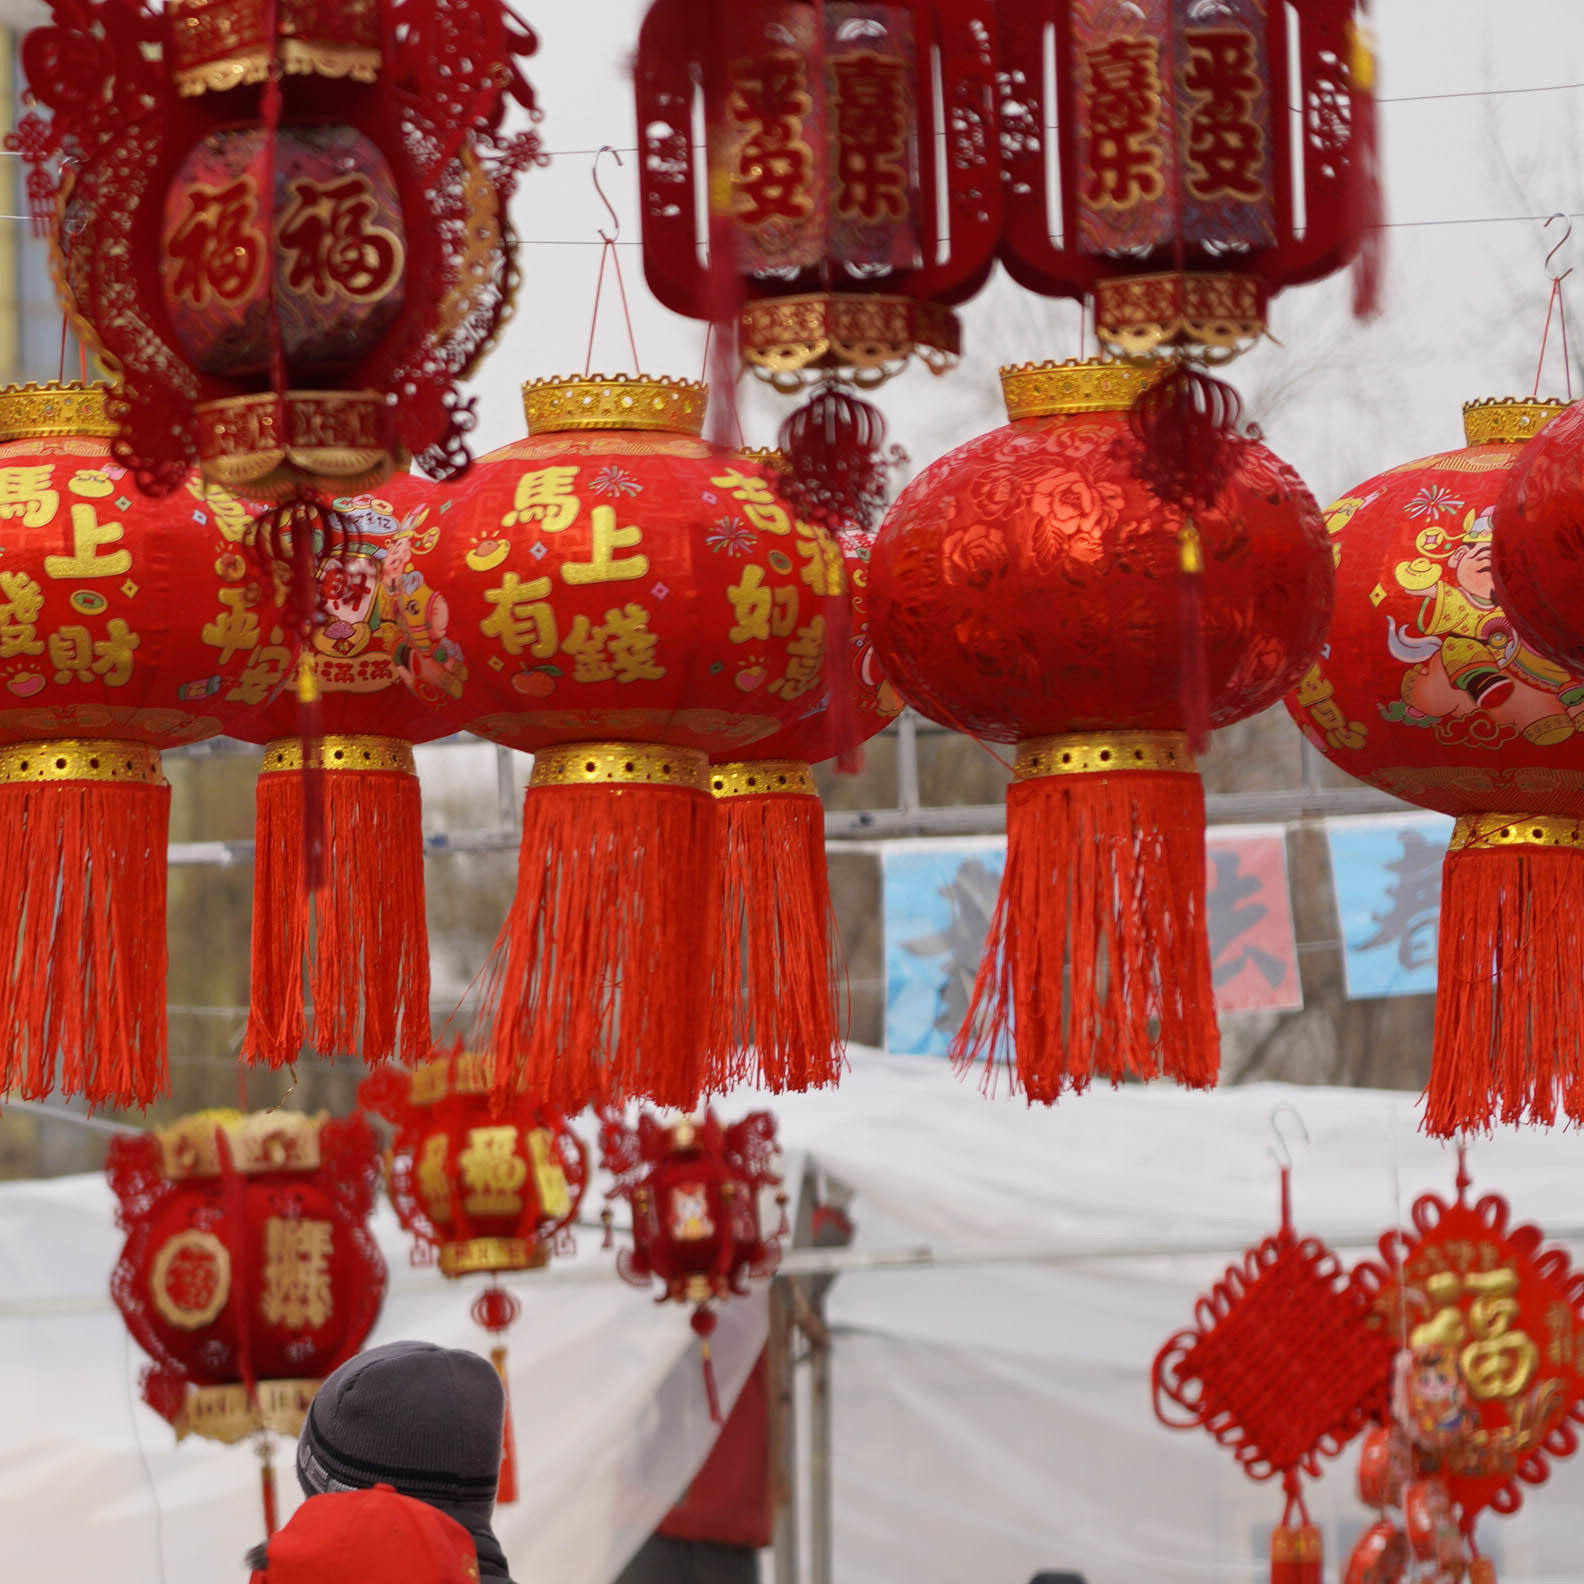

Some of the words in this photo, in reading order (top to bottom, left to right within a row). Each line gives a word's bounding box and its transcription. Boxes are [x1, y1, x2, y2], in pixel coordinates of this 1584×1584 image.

[1182, 27, 1266, 201] 平安
[163, 175, 260, 310] 福
[278, 174, 403, 301] 福
[502, 465, 651, 585] 馬上
[482, 571, 667, 683] 有錢
[1410, 1267, 1538, 1398] 福
